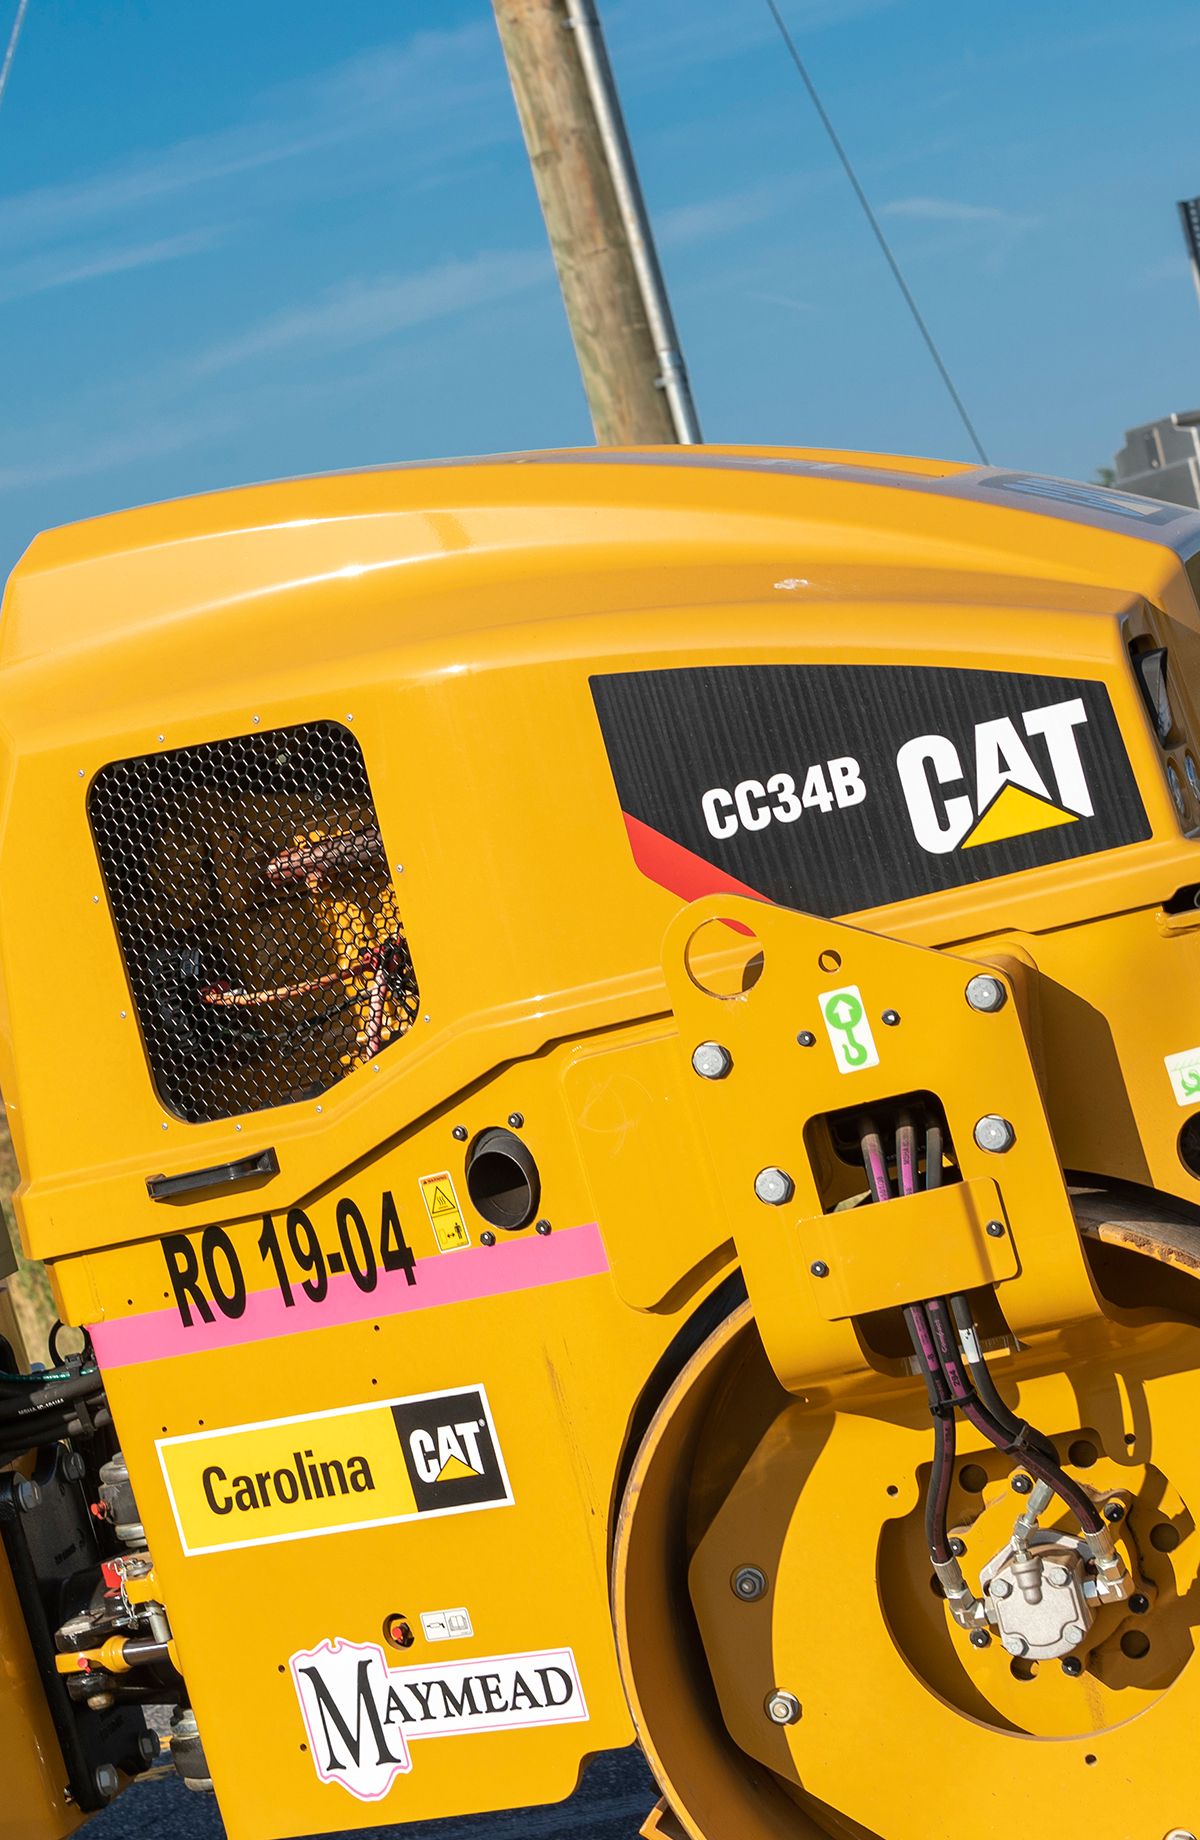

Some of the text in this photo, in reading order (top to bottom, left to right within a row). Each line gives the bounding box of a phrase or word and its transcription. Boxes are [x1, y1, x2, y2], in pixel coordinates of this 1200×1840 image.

[702, 698, 1095, 854] CC34B CAT
[160, 1190, 417, 1328] RO 19-04
[202, 1449, 376, 1516] Carolina
[298, 1659, 574, 1772] MAYMEAD
